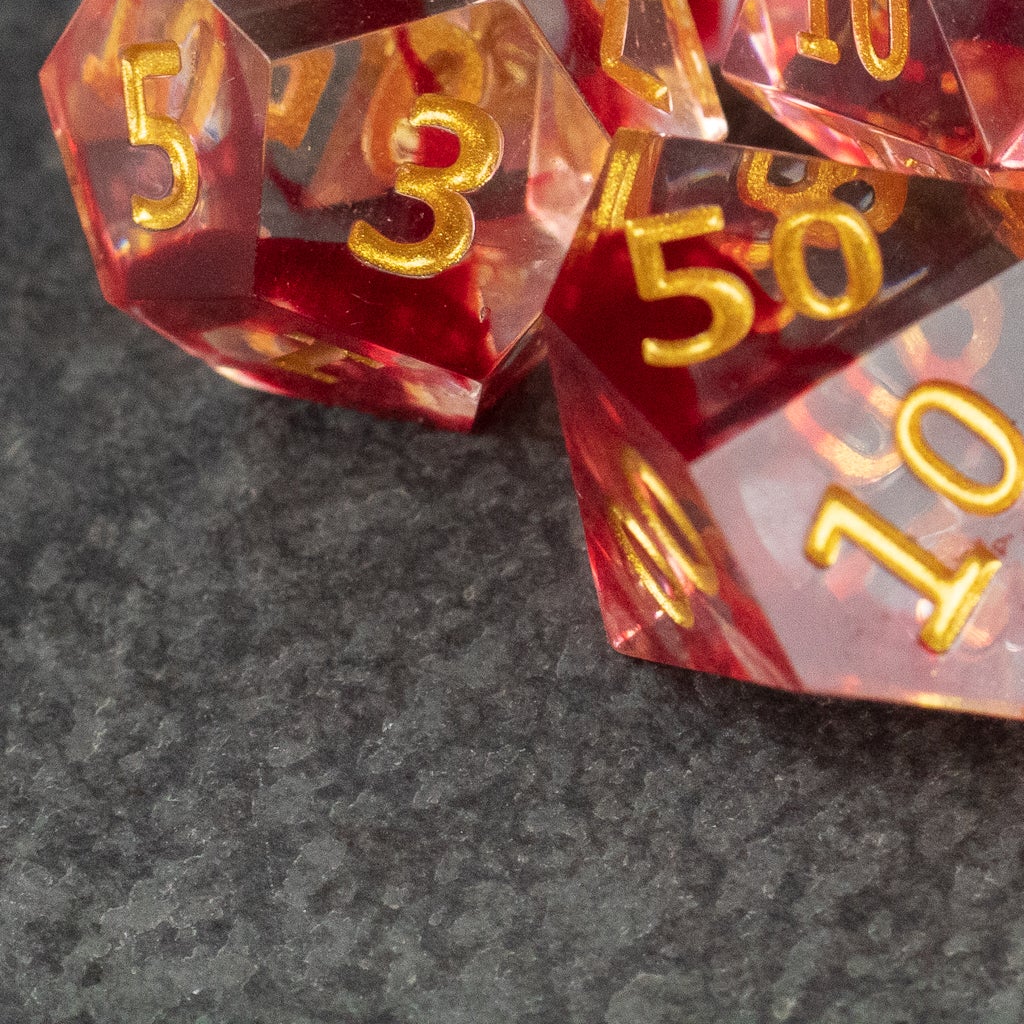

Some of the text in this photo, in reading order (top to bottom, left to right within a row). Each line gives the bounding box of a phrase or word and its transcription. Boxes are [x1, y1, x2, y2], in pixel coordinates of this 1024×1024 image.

[119, 40, 198, 231] 5
[347, 93, 503, 277] 3
[625, 201, 882, 366] 50
